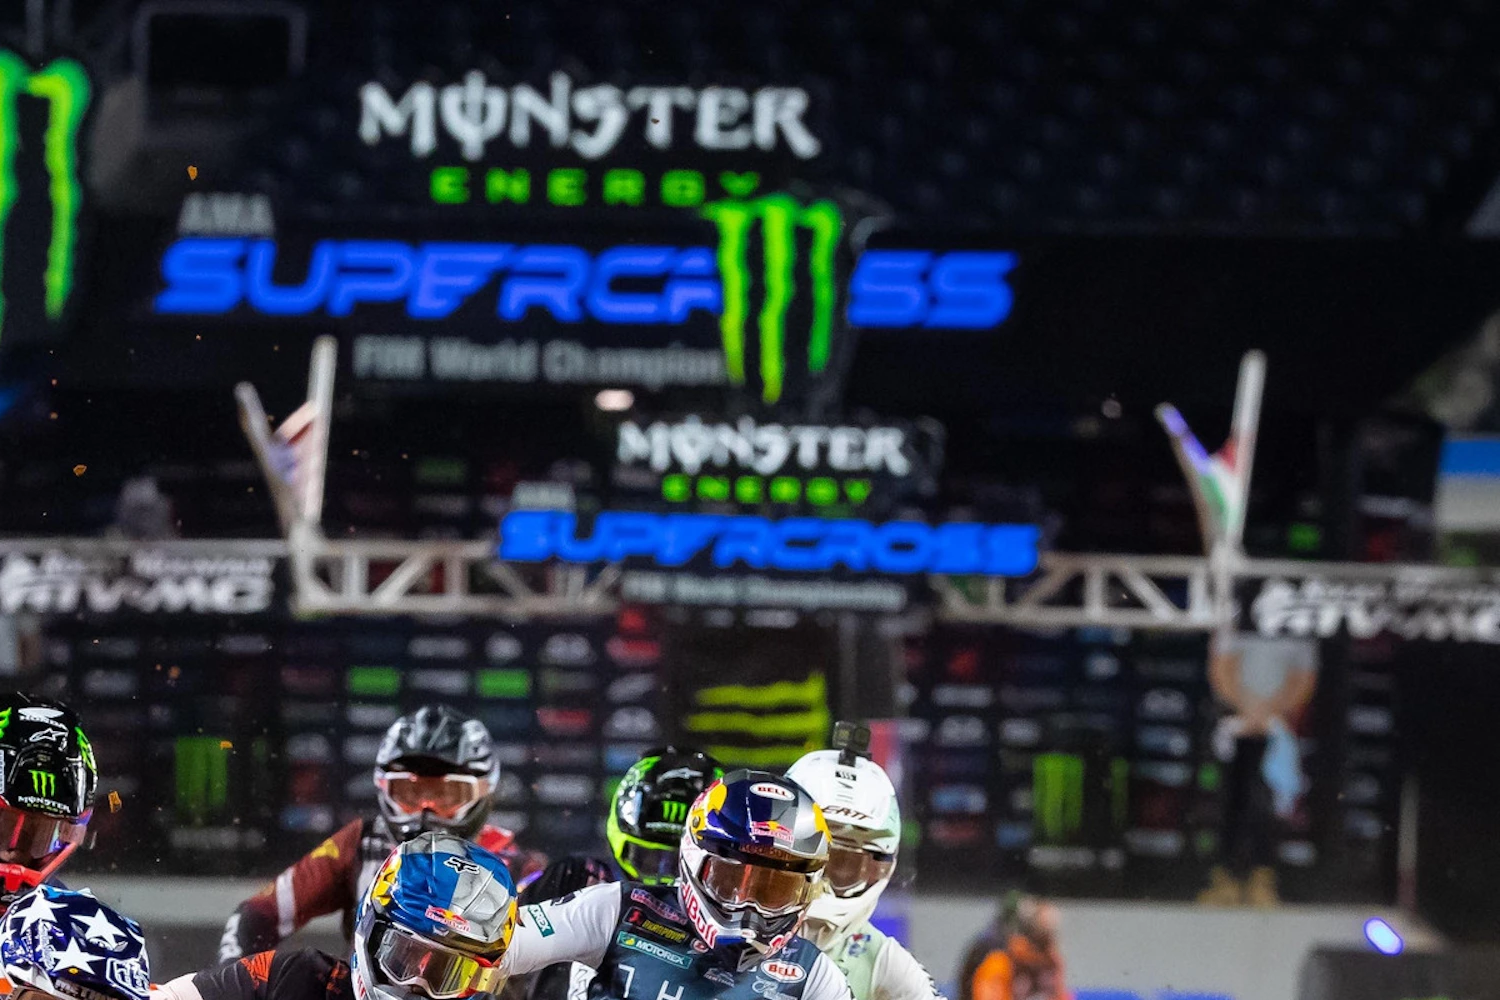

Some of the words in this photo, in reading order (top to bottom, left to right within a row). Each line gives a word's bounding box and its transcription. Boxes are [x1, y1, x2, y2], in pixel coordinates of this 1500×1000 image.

[359, 70, 821, 159] MONSTER
[155, 238, 1019, 329] SUPERCRSS
[431, 336, 536, 382] World
[618, 415, 910, 476] MONSTER
[18, 795, 71, 814] MONSTER
[756, 785, 788, 798] BELL
[636, 940, 686, 966] MOTOREX
[768, 962, 798, 979] BELL
